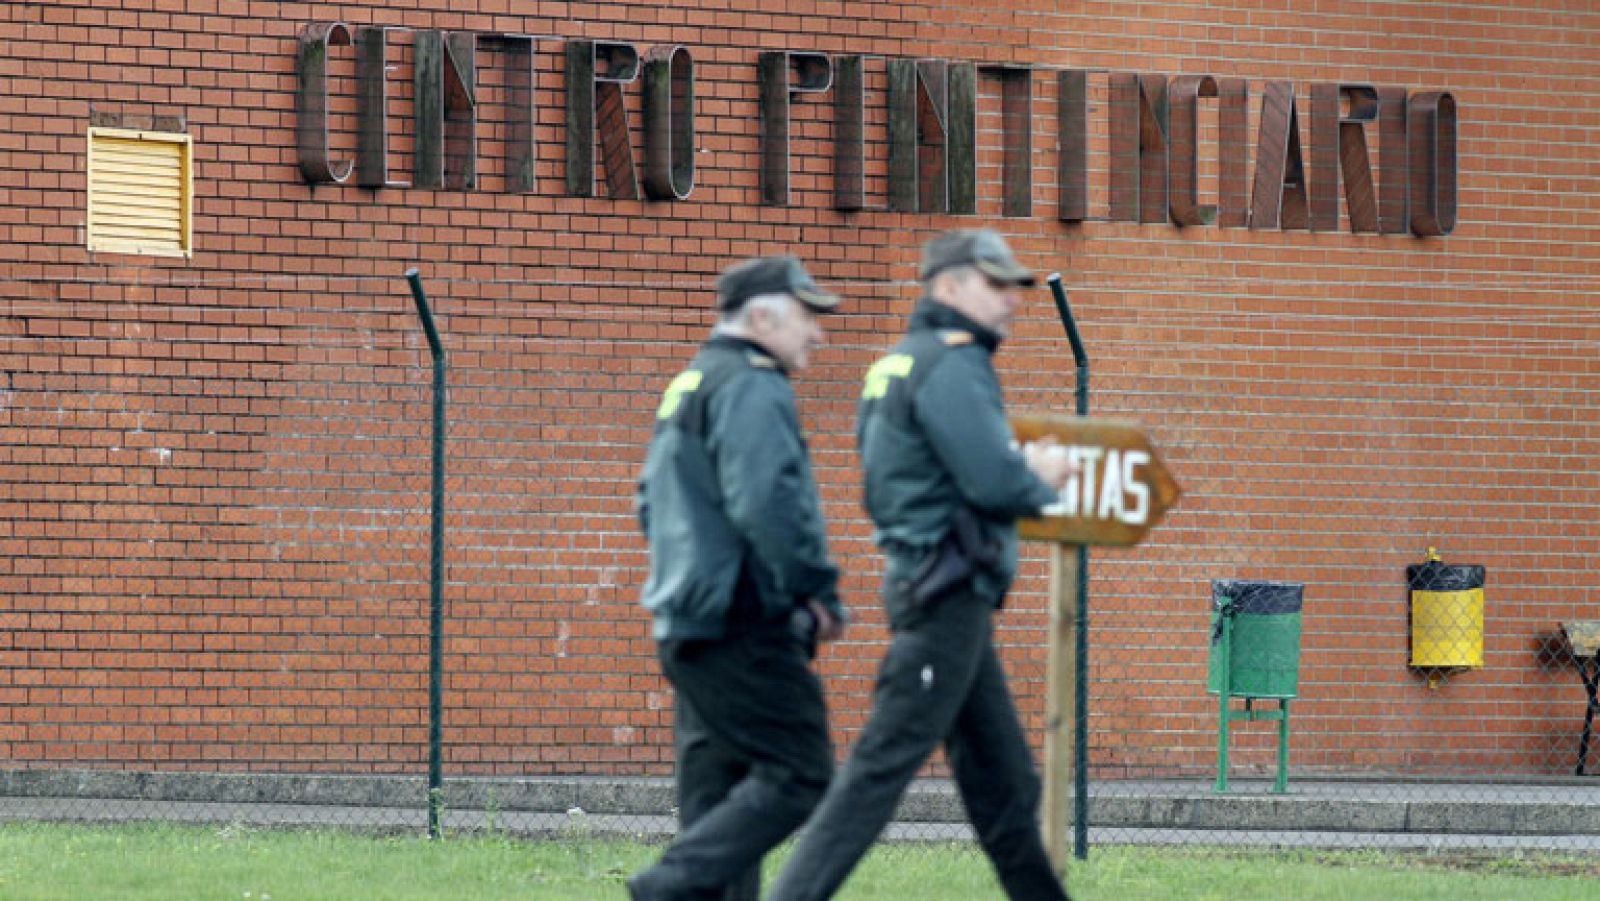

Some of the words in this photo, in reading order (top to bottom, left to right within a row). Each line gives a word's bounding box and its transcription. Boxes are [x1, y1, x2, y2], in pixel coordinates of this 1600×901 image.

[296, 22, 695, 200] CENTRO
[758, 50, 1457, 236] PENITENCIARIO
[1009, 439, 1151, 525] ITAS
